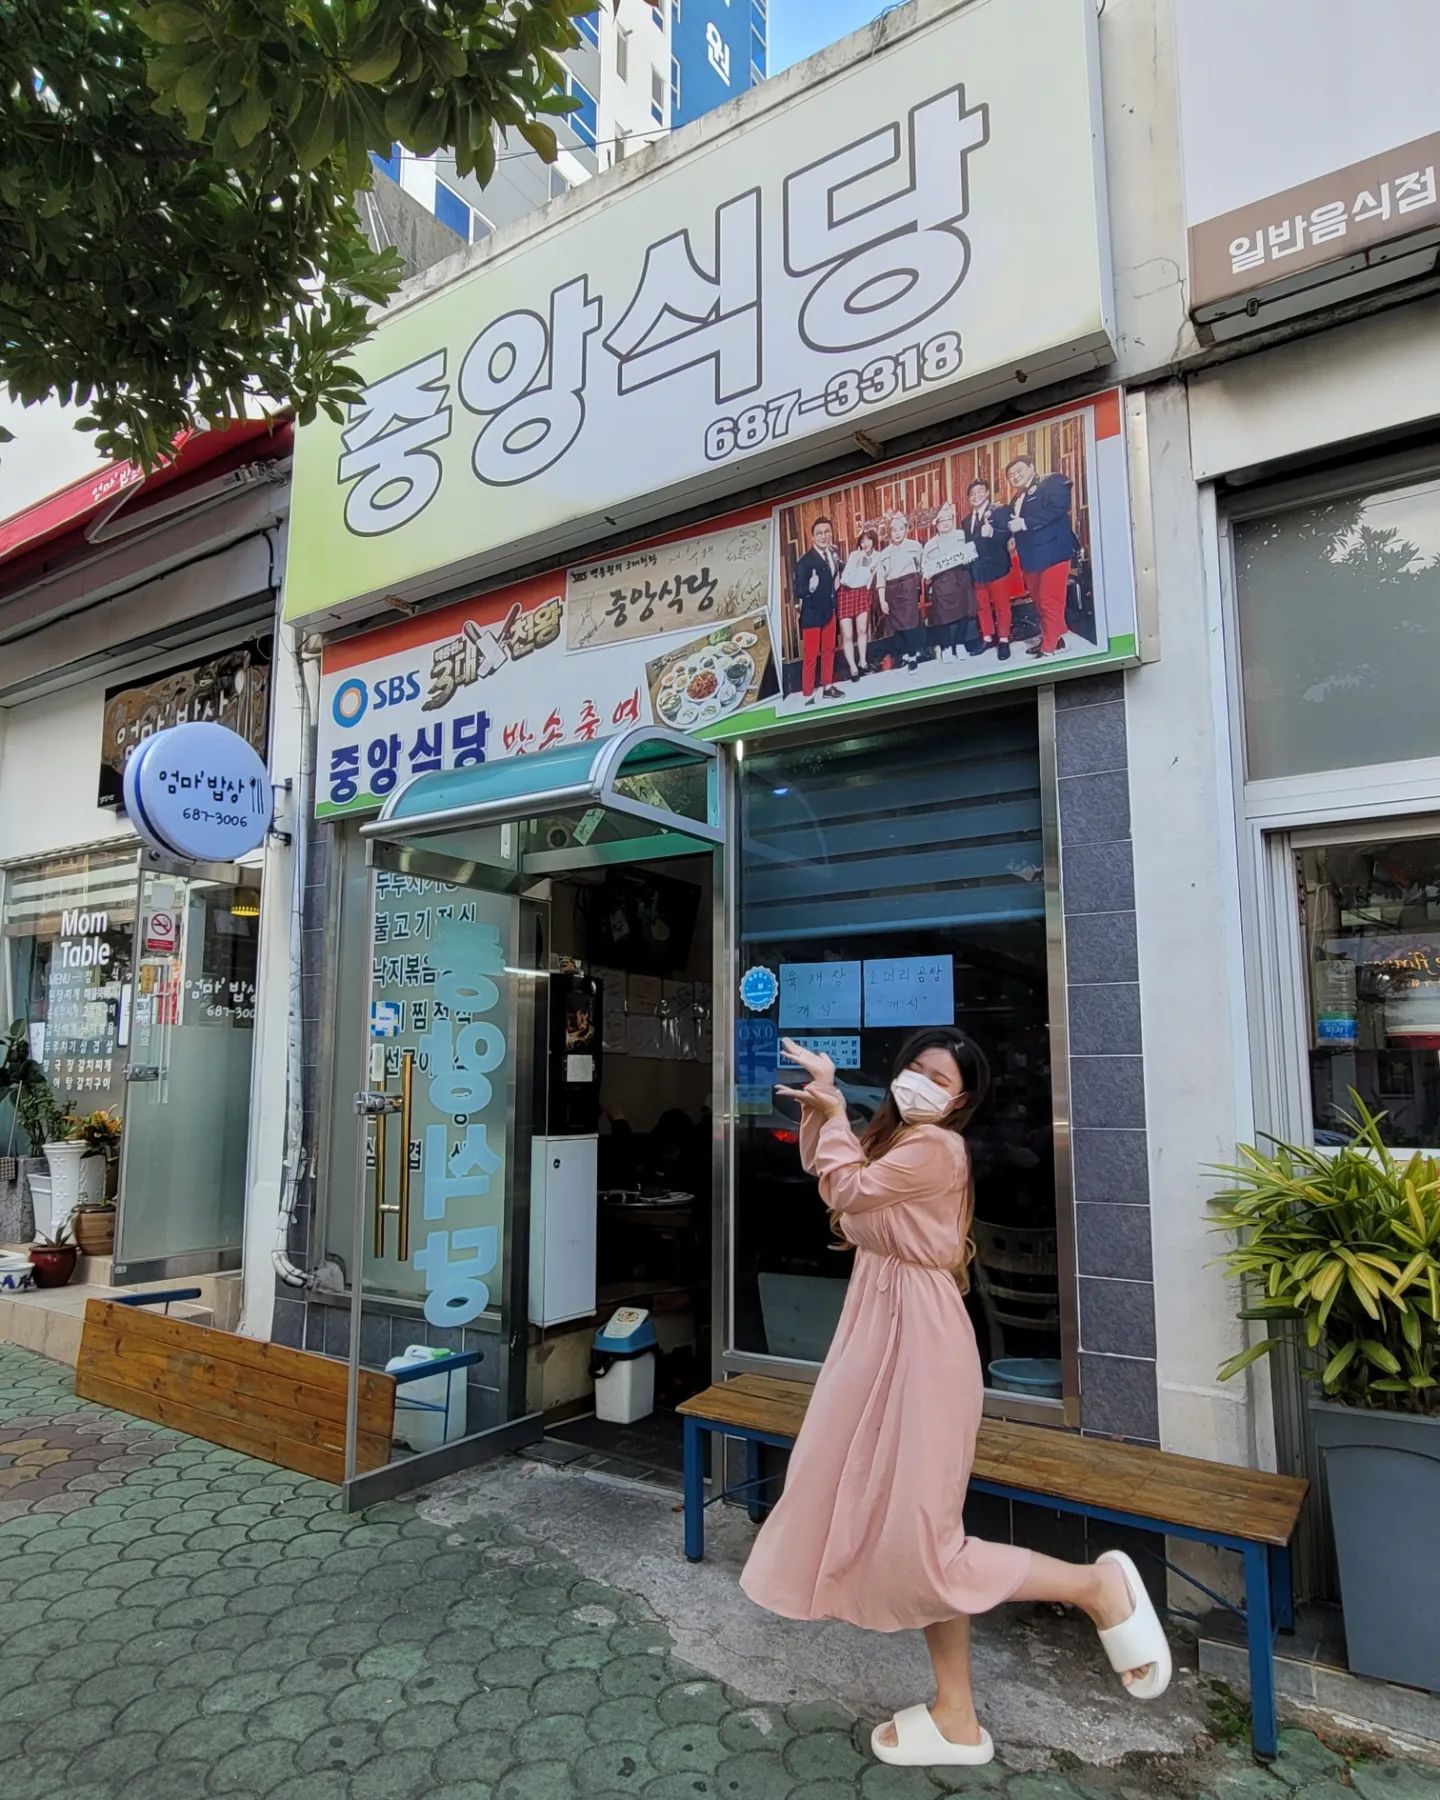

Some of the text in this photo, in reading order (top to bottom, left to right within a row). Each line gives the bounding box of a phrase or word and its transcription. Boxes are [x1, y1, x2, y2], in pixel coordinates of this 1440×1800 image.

[1229, 166, 1437, 274] 일반음식점
[338, 82, 989, 538] 중앙식당
[704, 331, 963, 462] 687-3318
[605, 567, 719, 628] 중앙식당
[373, 670, 421, 711] SBS
[329, 710, 490, 804] 중앙식당
[182, 807, 248, 828] 687-3006
[61, 910, 108, 937] Mom
[373, 907, 433, 943] 불고기
[61, 936, 111, 968] Table
